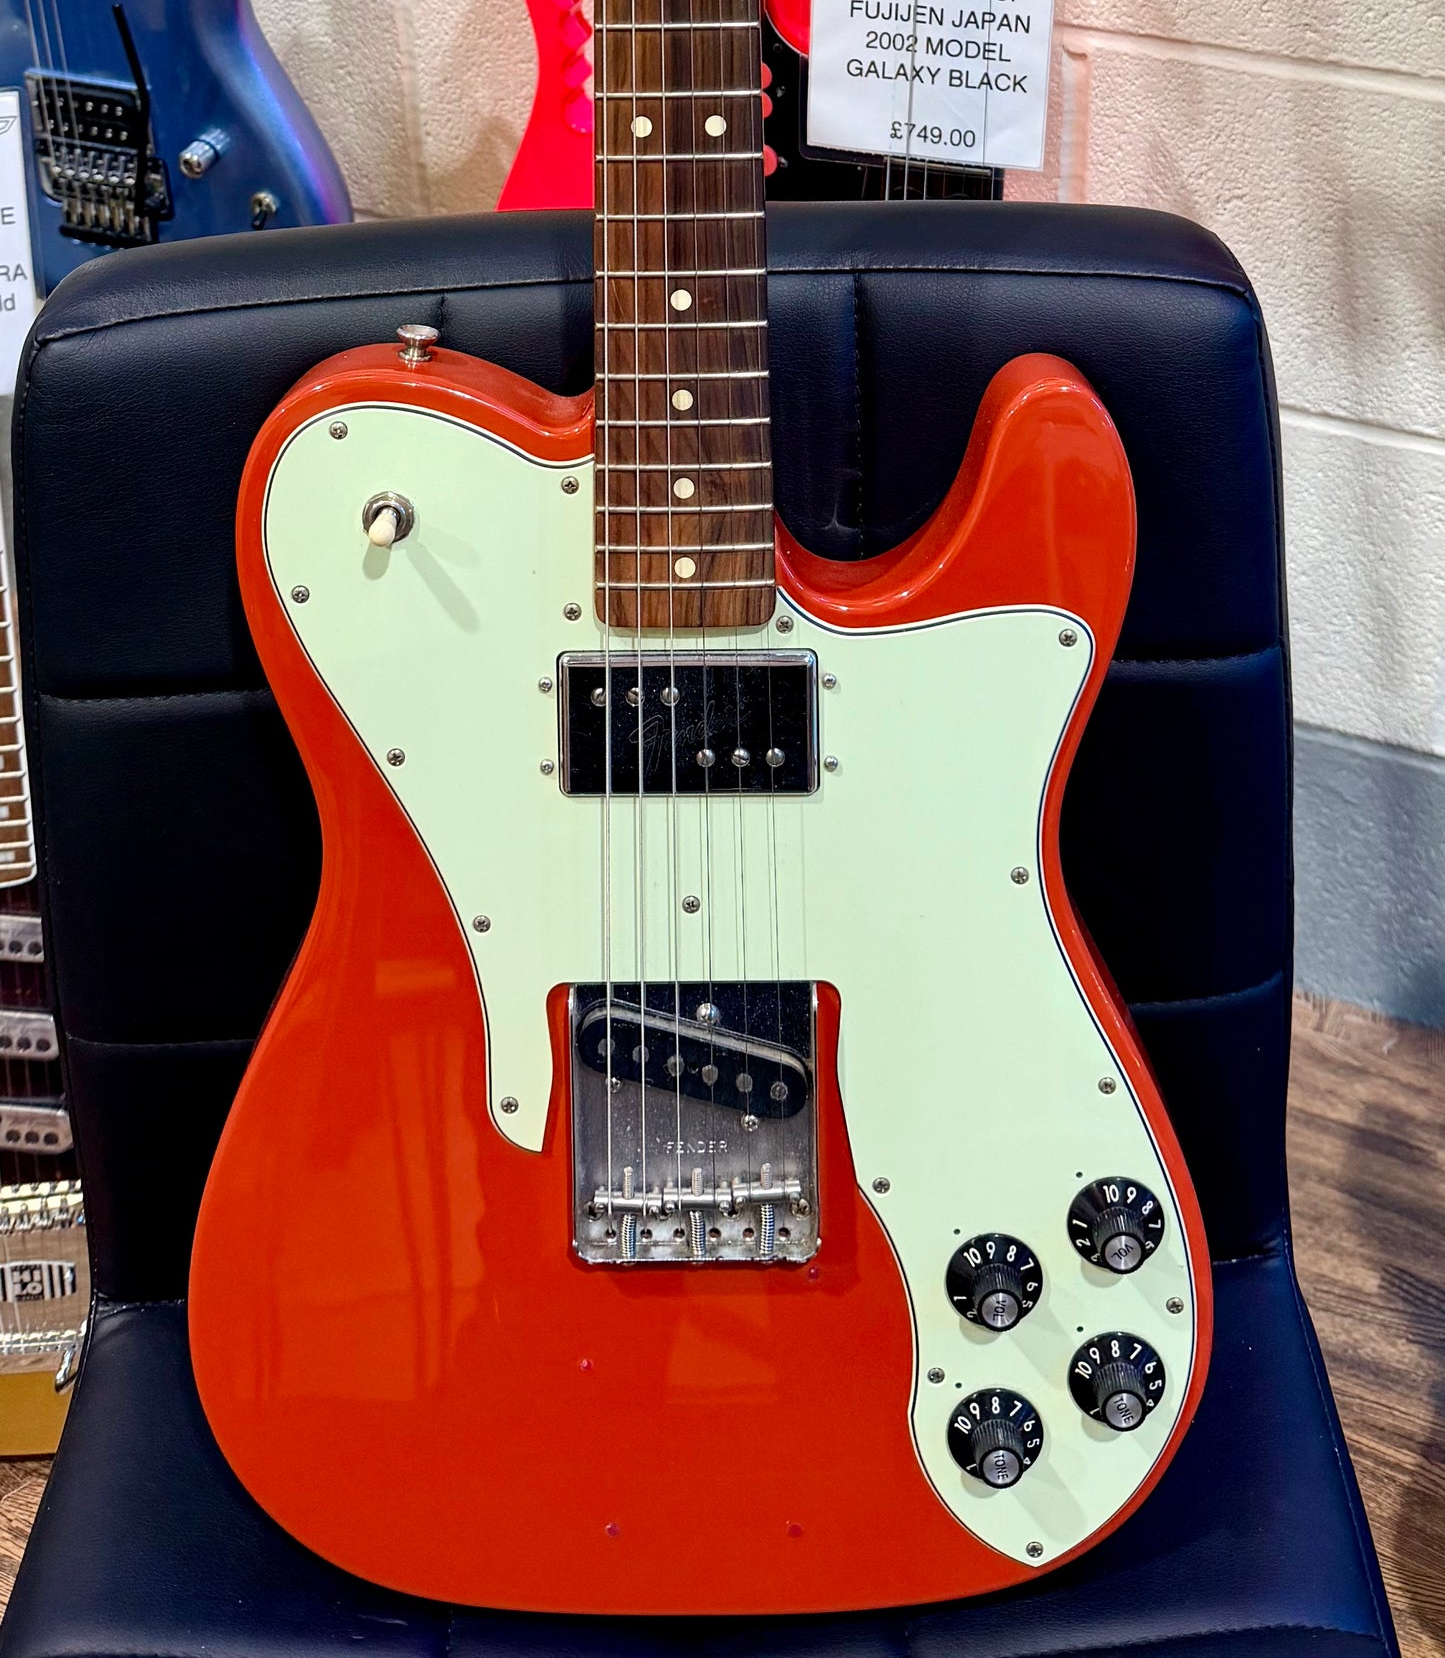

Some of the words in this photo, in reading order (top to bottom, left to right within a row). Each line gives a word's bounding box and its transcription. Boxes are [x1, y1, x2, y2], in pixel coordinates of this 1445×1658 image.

[850, 0, 944, 26] FUJIJEN
[952, 10, 1031, 33] JAPAN
[866, 31, 918, 53] 2002
[926, 37, 1011, 62] MODEL
[847, 59, 941, 84] GALAXY
[949, 69, 1028, 93] BLACK
[890, 121, 976, 147] £749.00
[666, 1141, 728, 1154] FENDER
[1102, 1184, 1119, 1203] 10
[1127, 1186, 1136, 1204] 9
[1141, 1200, 1153, 1215] 8
[1072, 1219, 1088, 1228] 1
[1148, 1219, 1161, 1228] 7
[1075, 1238, 1091, 1247] 2
[963, 1247, 981, 1268] 10
[986, 1241, 996, 1259] 9
[1006, 1245, 1017, 1262] 8
[1111, 1244, 1134, 1260] VOL
[1020, 1258, 1035, 1270] 7
[1026, 1282, 1038, 1291] 6
[992, 1300, 1007, 1321] VOL
[1075, 1361, 1092, 1379] 10
[1089, 1347, 1100, 1364] 9
[1111, 1340, 1120, 1357] 8
[1129, 1343, 1142, 1360] 7
[1145, 1361, 1157, 1374] 6
[1149, 1379, 1162, 1390] 5
[954, 1415, 971, 1434] 10
[969, 1402, 980, 1420] 9
[991, 1396, 1000, 1414] 8
[1009, 1400, 1023, 1417] 7
[1114, 1397, 1134, 1424] TONE
[1023, 1420, 1036, 1432] 6
[1026, 1438, 1040, 1448] 5
[994, 1453, 1009, 1480] TONE
